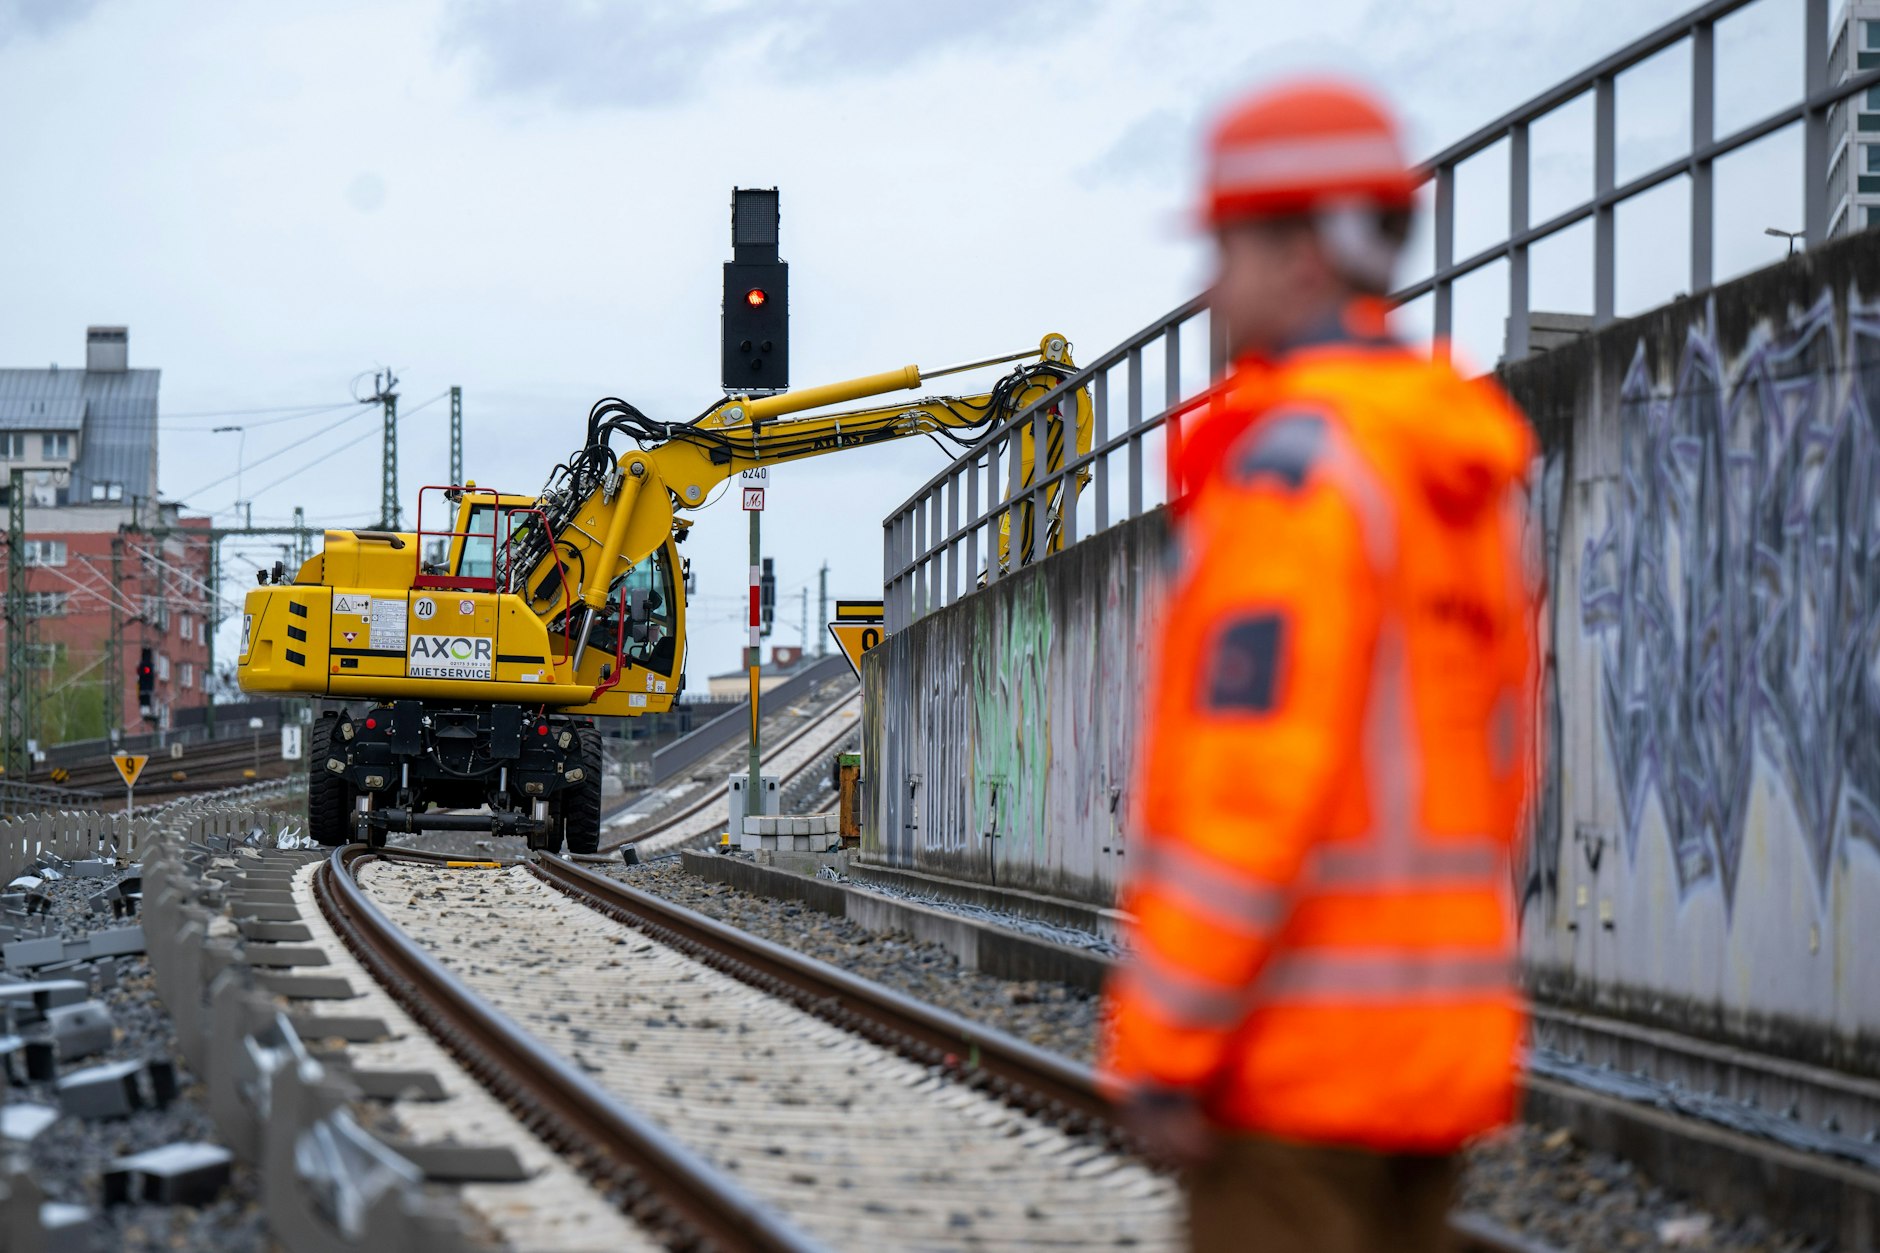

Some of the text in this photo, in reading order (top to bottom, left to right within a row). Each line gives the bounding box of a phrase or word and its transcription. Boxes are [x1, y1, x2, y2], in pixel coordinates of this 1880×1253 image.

[742, 467, 767, 479] 6240
[419, 601, 432, 615] 20
[411, 636, 491, 660] AXOR
[410, 667, 491, 679] MIETSERVICE
[126, 757, 135, 775] 9
